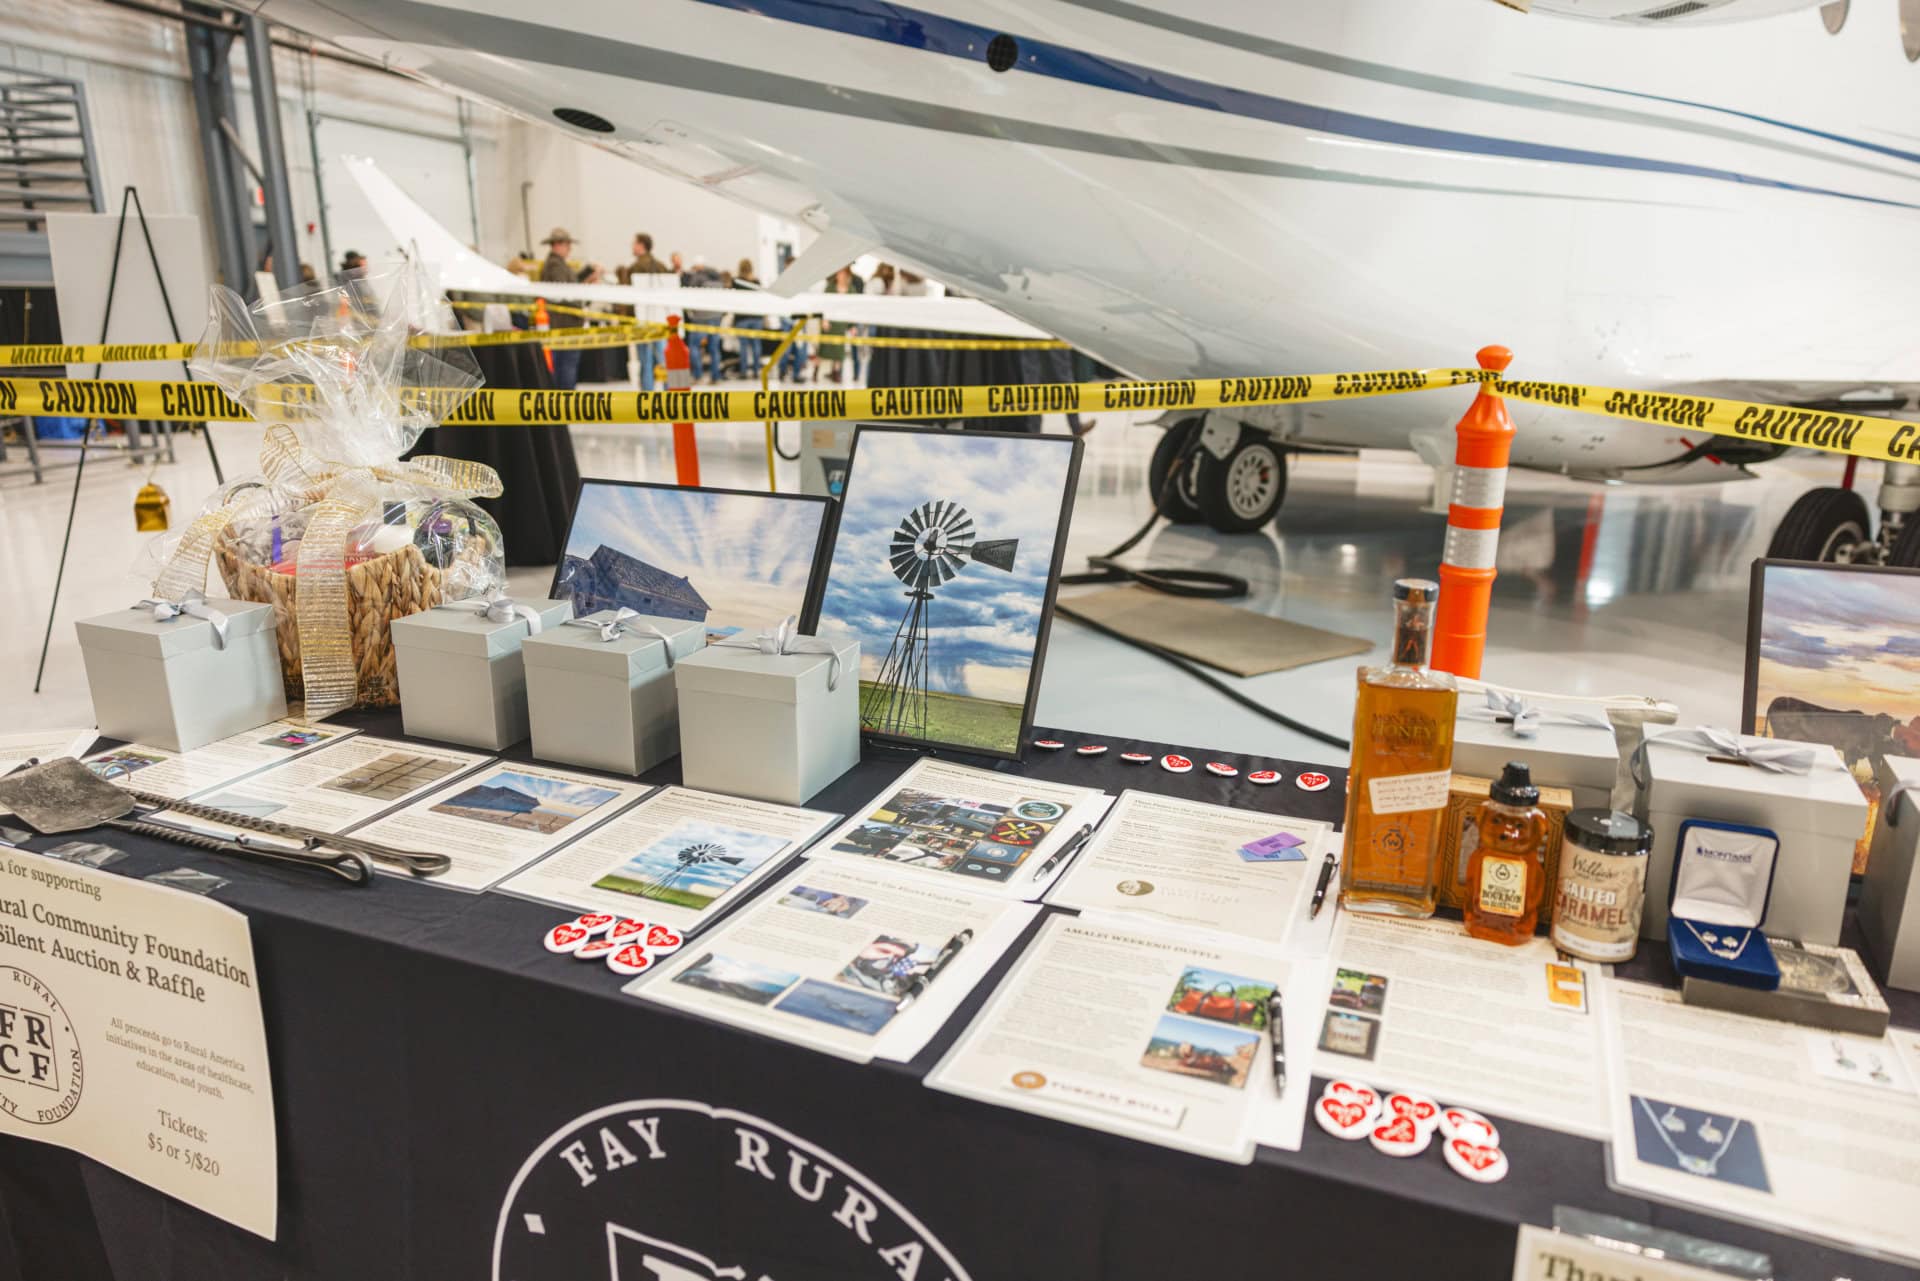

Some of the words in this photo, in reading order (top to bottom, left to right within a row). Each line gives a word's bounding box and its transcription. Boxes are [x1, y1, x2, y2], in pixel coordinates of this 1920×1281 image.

[39, 381, 137, 415] CAUTION
[519, 392, 612, 421] CAUTION
[637, 391, 729, 421] CAUTION
[754, 390, 846, 418] CAUTION
[871, 388, 963, 416] CAUTION
[988, 385, 1079, 412] CAUTION
[1104, 381, 1195, 408] CAUTION
[1219, 376, 1312, 403] CAUTION
[1334, 371, 1427, 395] CAUTION
[1605, 391, 1714, 428] CAUTION
[1734, 405, 1864, 449] CAUTION
[8, 860, 28, 877] for
[31, 869, 102, 901] supporting
[0, 924, 46, 955] Silent
[51, 938, 122, 976] Auction
[126, 961, 141, 983] &
[146, 965, 206, 1003] Raffle
[32, 903, 139, 955] Community
[144, 933, 251, 988] Foundation
[13, 971, 57, 1012] RURAL
[105, 1031, 147, 1055] initiatives
[148, 1047, 158, 1058] in
[159, 1050, 172, 1062] the
[174, 1056, 195, 1071] areas
[197, 1063, 206, 1076] of
[110, 1017, 123, 1030] All
[125, 1022, 160, 1042] proceeds
[162, 1036, 172, 1047] go
[173, 1039, 183, 1050] to
[184, 1041, 207, 1058] Rural
[210, 1049, 246, 1072] America
[37, 1049, 81, 1122] FOUNDATION
[136, 1059, 179, 1085] education,
[180, 1075, 195, 1089] and
[157, 1109, 208, 1143] Tickets:
[148, 1132, 163, 1153] $5
[166, 1143, 180, 1160] or
[184, 1148, 220, 1177] 5/$20
[560, 1117, 667, 1187] FAY
[735, 1127, 953, 1281] RURA
